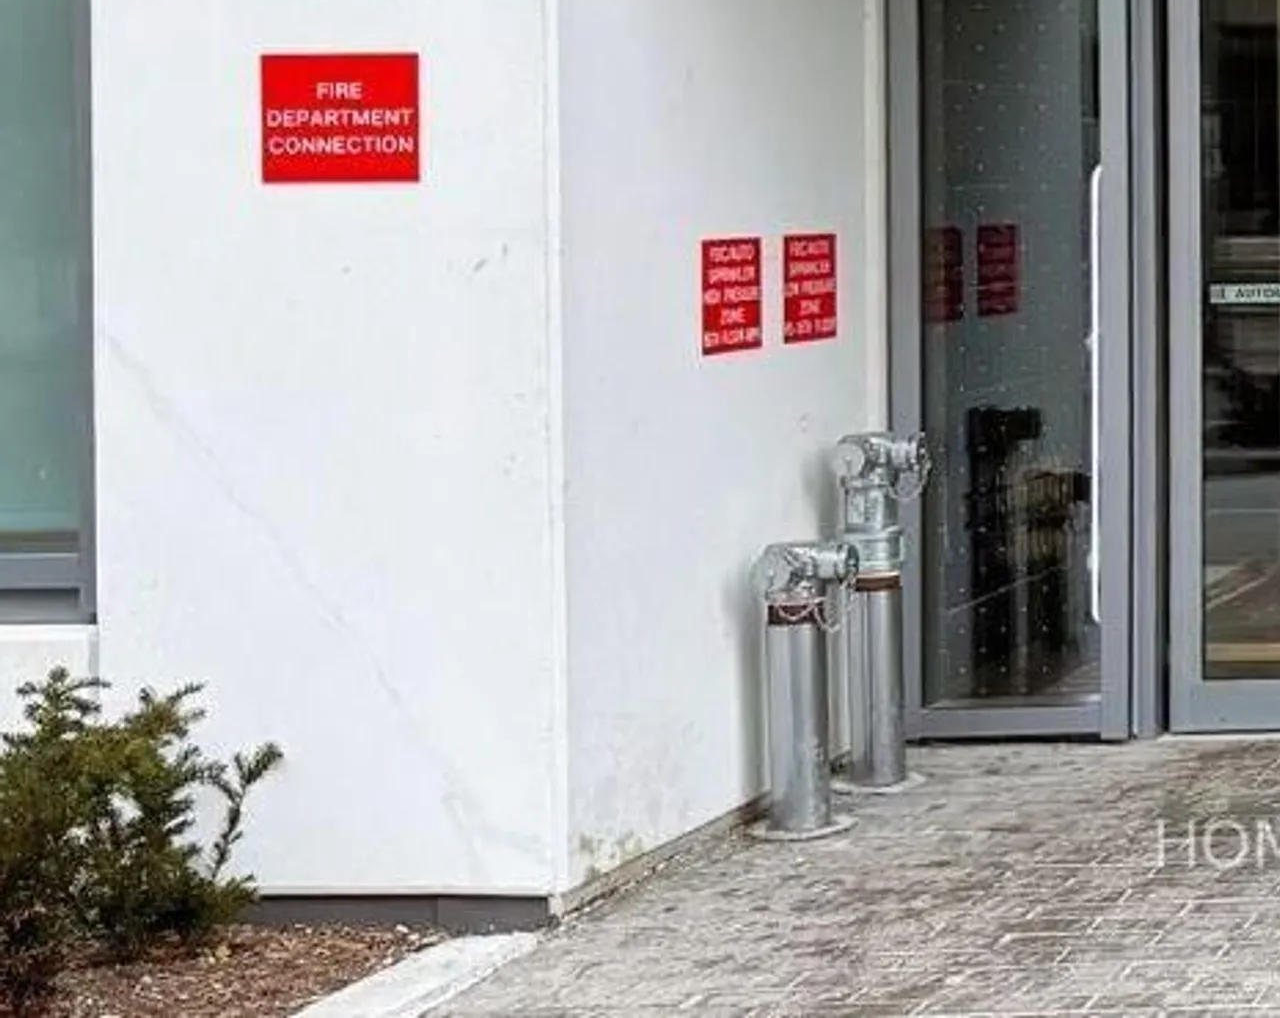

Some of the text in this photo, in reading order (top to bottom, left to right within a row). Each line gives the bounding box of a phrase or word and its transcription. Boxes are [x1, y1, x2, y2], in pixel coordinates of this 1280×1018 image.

[316, 82, 363, 100] FIRE
[266, 108, 414, 127] DEPARTMENT
[269, 134, 414, 155] CONNECTION
